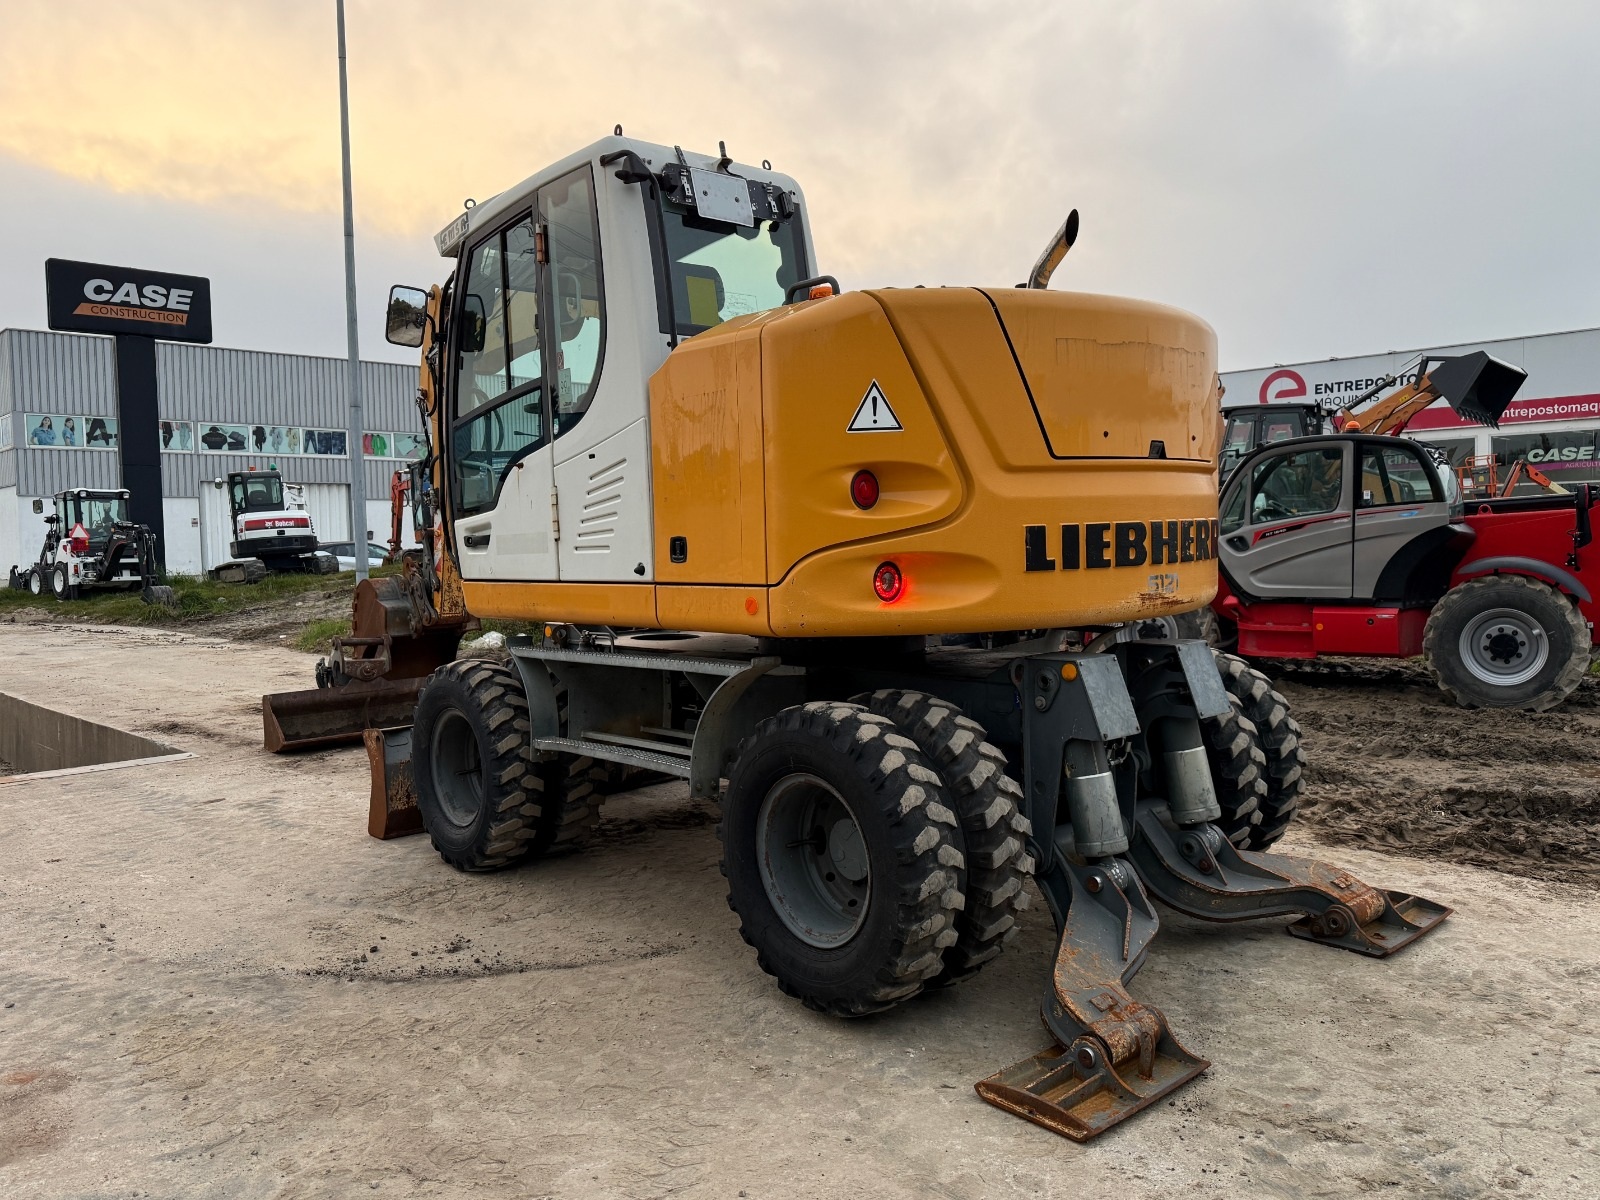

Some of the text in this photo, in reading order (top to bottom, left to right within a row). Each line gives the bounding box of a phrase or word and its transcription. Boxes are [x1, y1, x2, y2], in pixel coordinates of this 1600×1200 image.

[83, 279, 194, 311] CASE
[90, 305, 184, 323] CONSTRUCTION
[1501, 402, 1600, 418] ntrepostomaq
[1527, 446, 1595, 462] CASE
[1565, 460, 1600, 469] AGRICULT
